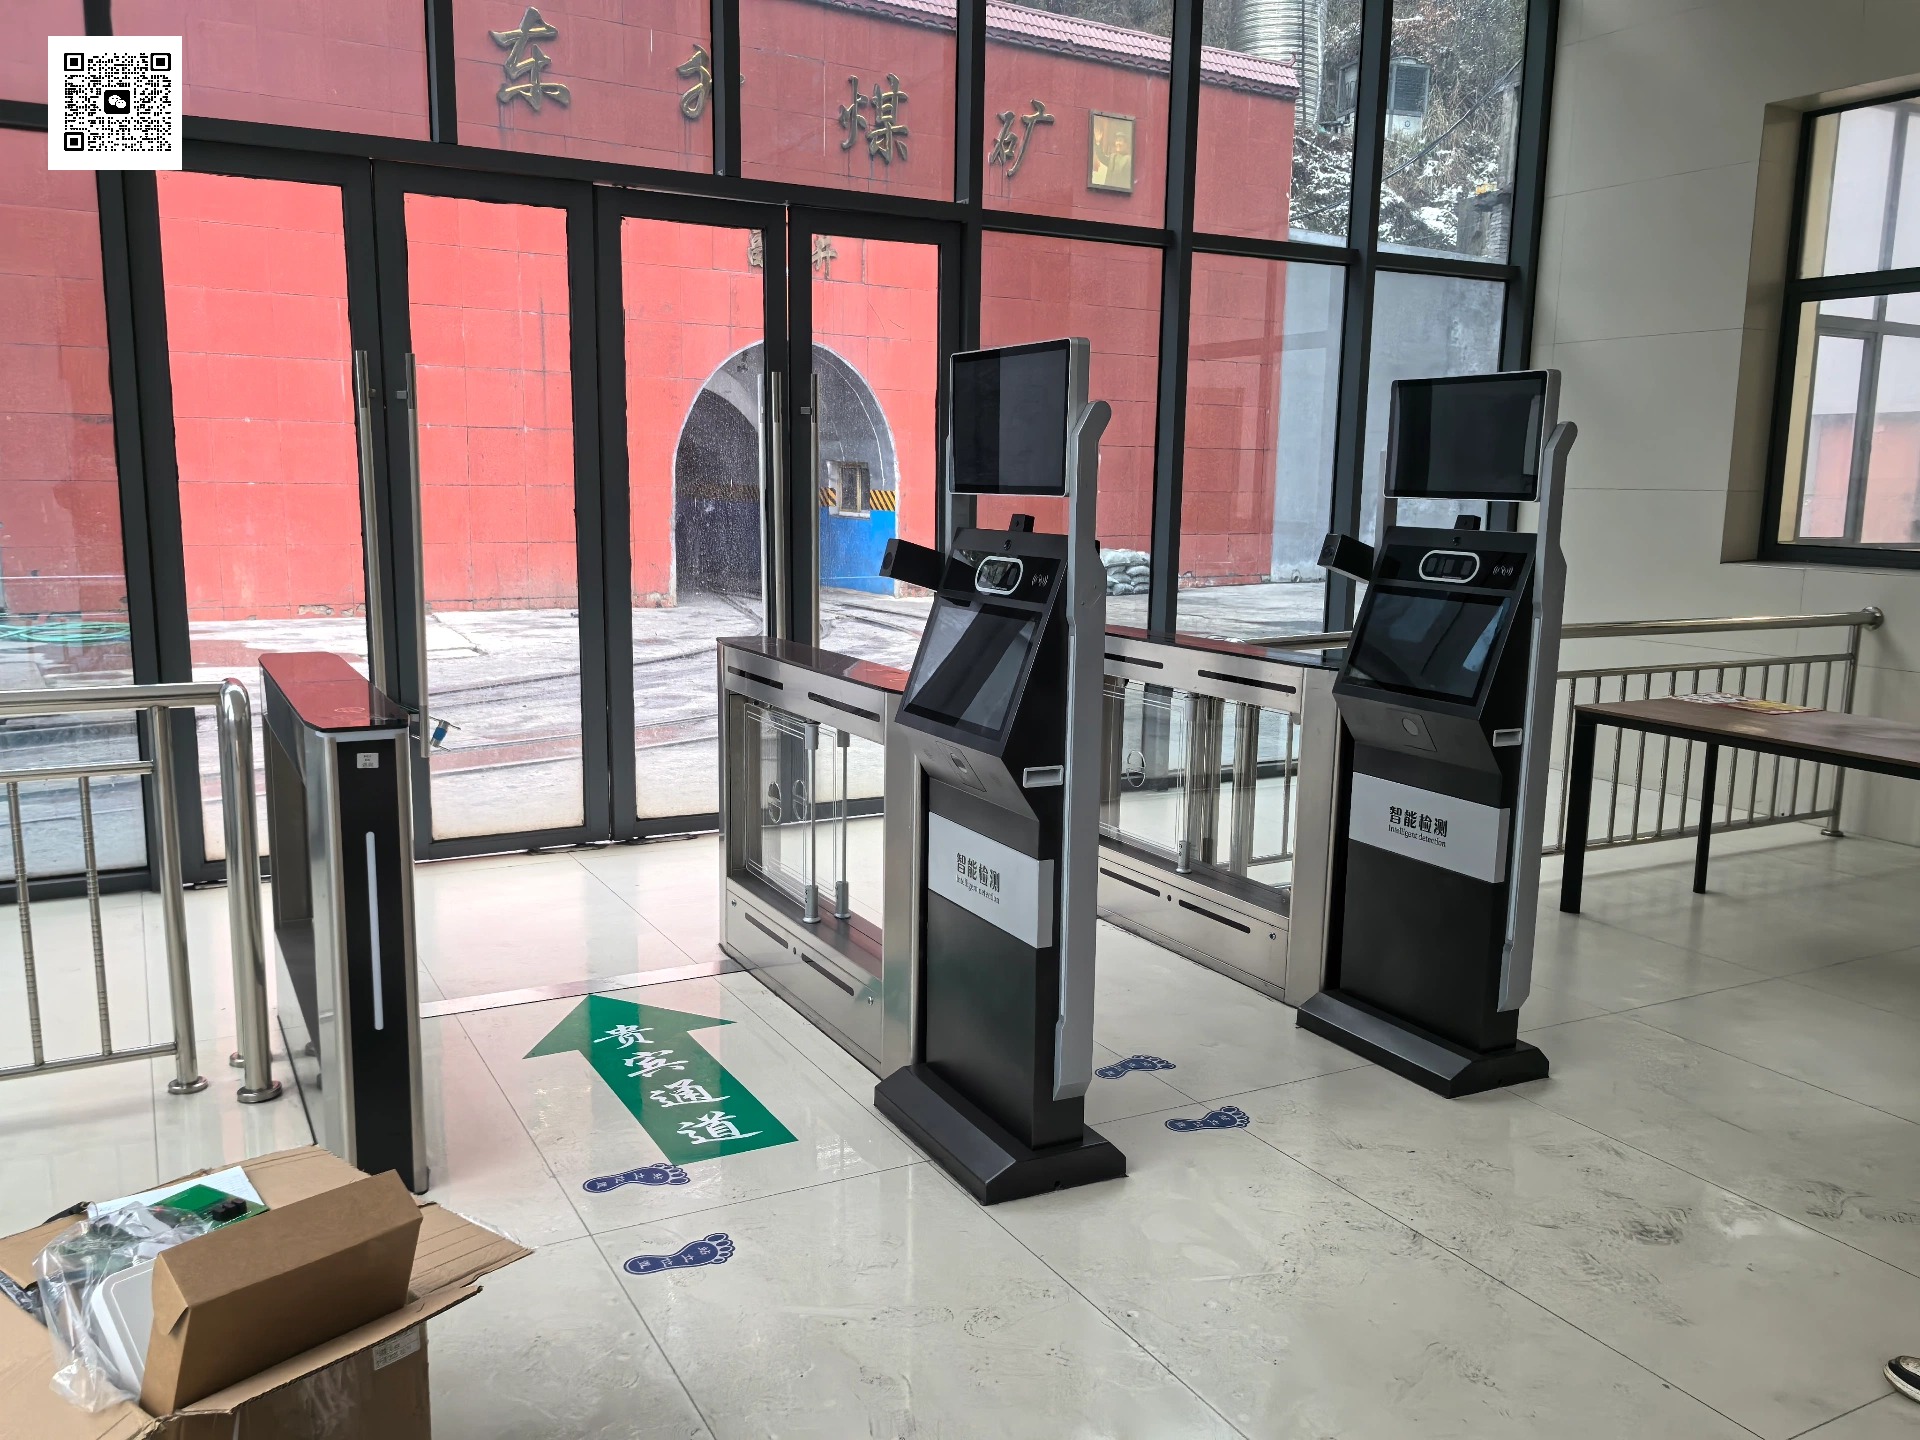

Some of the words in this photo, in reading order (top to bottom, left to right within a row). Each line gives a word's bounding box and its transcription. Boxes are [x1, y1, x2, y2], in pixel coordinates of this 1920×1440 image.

[1388, 824, 1418, 839] Intelligent
[1419, 832, 1446, 848] detection
[1389, 806, 1448, 838] 智能检测
[956, 852, 1000, 893] 智能检测
[593, 1024, 764, 1145] 贵宾通道
[596, 1172, 664, 1189] 站立位置
[637, 1246, 711, 1270] 站立位置
